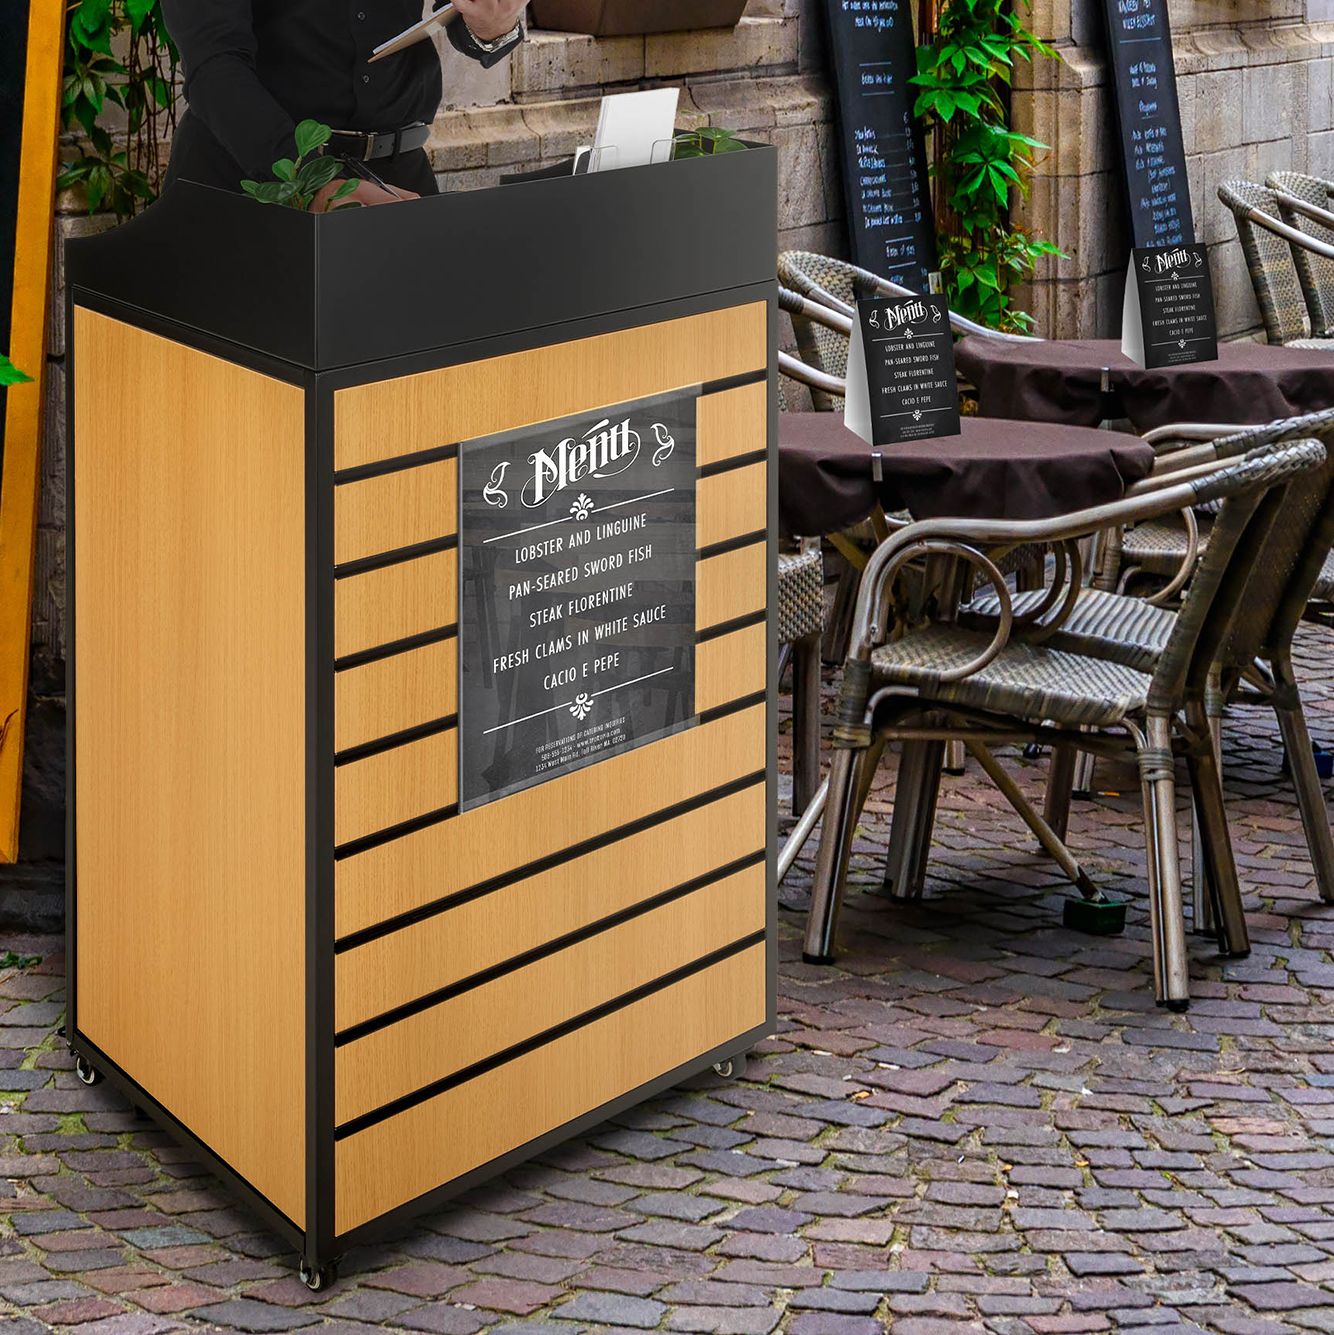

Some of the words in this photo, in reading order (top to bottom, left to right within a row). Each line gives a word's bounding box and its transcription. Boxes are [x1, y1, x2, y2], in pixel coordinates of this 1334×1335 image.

[516, 537, 563, 564] LOBSTER
[568, 529, 591, 549] AND
[597, 513, 646, 540] LINGUINE
[509, 567, 578, 600] PAN-SEARED
[584, 553, 623, 577] SWORD
[629, 544, 652, 564] FISH
[530, 604, 562, 628] STEAK
[569, 582, 633, 615] FLORENTINE
[494, 648, 529, 673] FRESH
[535, 635, 572, 659] CLAMS
[578, 629, 589, 646] IN
[594, 617, 627, 640] WHITE
[633, 604, 666, 628] SAUCE
[544, 667, 576, 690] CACIO
[583, 662, 588, 677] E
[594, 652, 619, 674] PEPE
